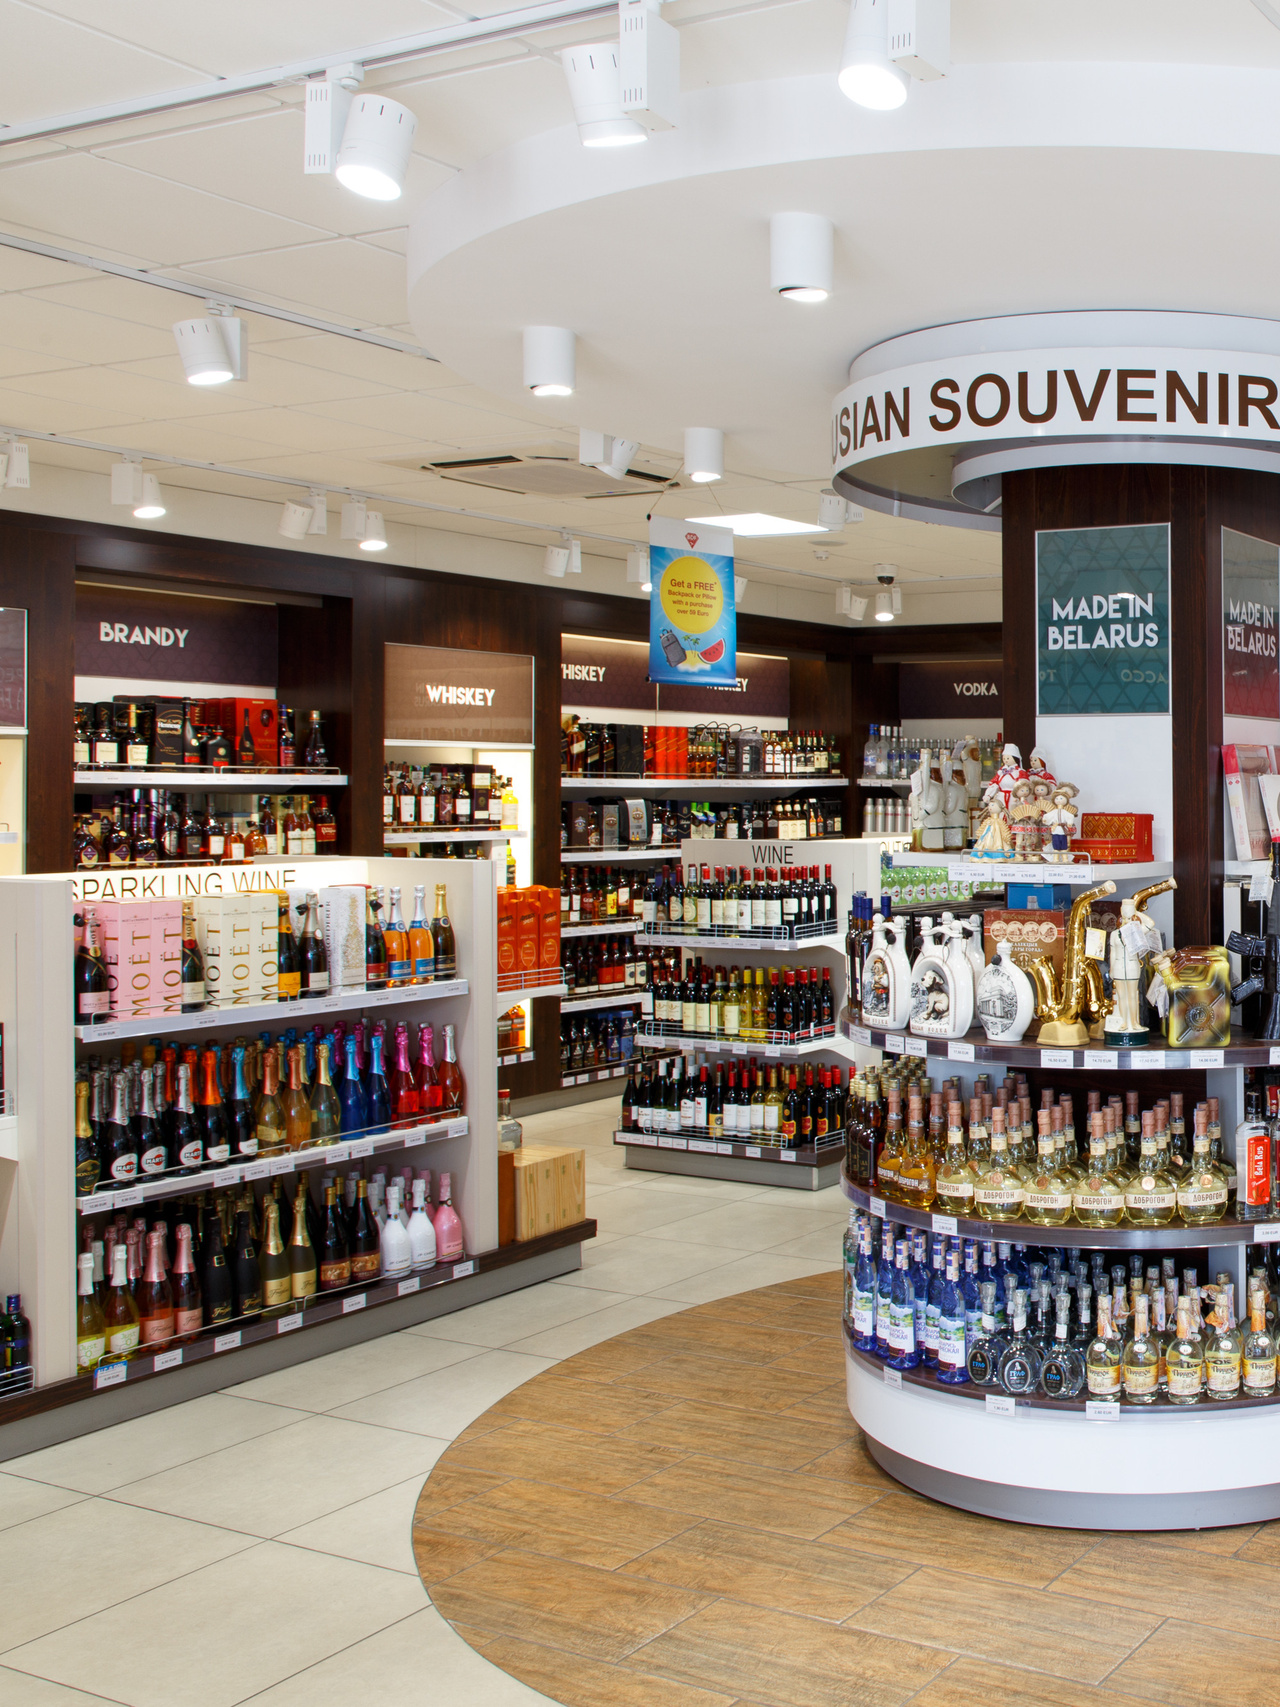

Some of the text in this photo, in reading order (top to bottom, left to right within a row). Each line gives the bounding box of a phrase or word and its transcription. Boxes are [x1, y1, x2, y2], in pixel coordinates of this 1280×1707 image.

[668, 589, 694, 600] Backpack
[702, 592, 717, 600] Pillow
[670, 578, 685, 588] Get
[690, 601, 713, 609] purchase
[1052, 592, 1153, 621] MADE IN
[1230, 598, 1274, 628] MADE IN
[100, 621, 189, 648] BRANDY
[1048, 623, 1159, 650] BELARUS
[1228, 627, 1276, 657] BELARUS
[561, 664, 606, 682] HISKEY
[426, 684, 496, 707] WHISKEY
[953, 682, 999, 696] VODKA
[752, 844, 794, 865] WINE
[70, 869, 296, 900] SPARKLING WINE
[160, 928, 182, 1012] MOËT
[203, 923, 220, 1008] MOËT
[229, 923, 249, 1005] MOËT
[258, 917, 279, 1001] MOËT
[128, 930, 150, 1016] MOËT
[1254, 1146, 1264, 1176] Bela Rus
[983, 1190, 1015, 1199] ДОБРОГОН
[1029, 1195, 1059, 1205] ДОБРОГОН
[1081, 1196, 1112, 1206] ДОБРОГОН
[1133, 1195, 1166, 1206] ДОБРОГОН
[1193, 1191, 1224, 1203] ДОБРОГОН
